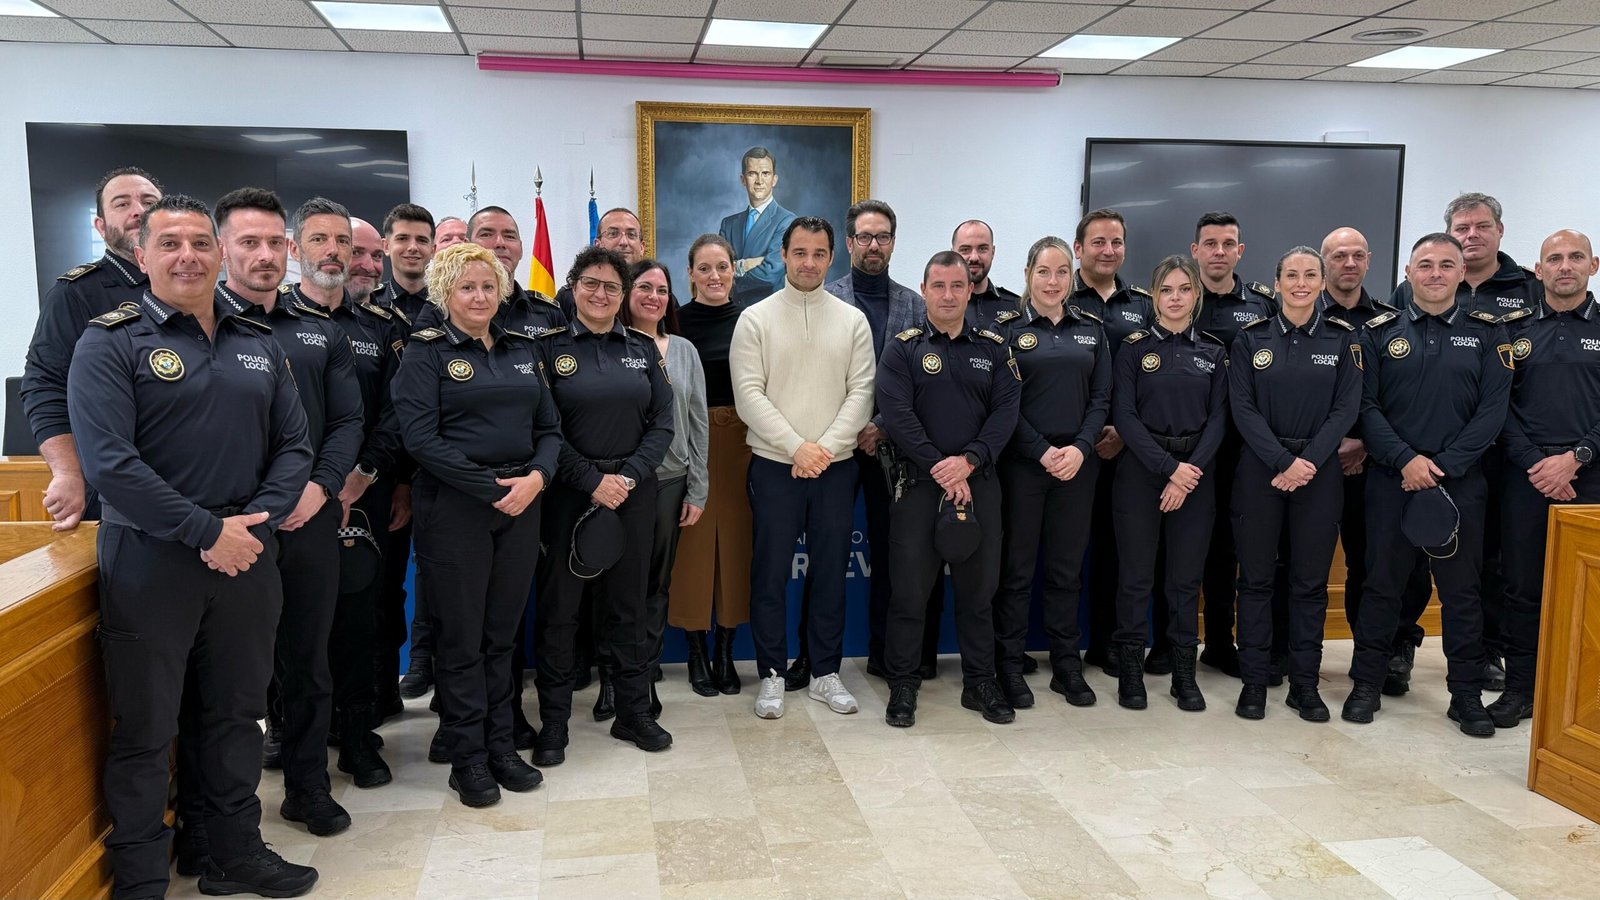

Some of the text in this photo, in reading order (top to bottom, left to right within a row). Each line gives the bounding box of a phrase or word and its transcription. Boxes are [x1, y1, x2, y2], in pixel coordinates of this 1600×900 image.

[1496, 296, 1524, 304] POLICIA
[1233, 311, 1259, 320] POLICIA
[296, 332, 328, 342] POLICIA
[352, 340, 379, 349] POLICIA
[356, 347, 378, 356] LOCAL
[237, 354, 270, 366] POLICIA
[621, 357, 648, 366] POLICIA
[969, 357, 993, 366] POLICIA
[1193, 356, 1216, 370] POLICIA
[244, 361, 270, 373] LOCAL
